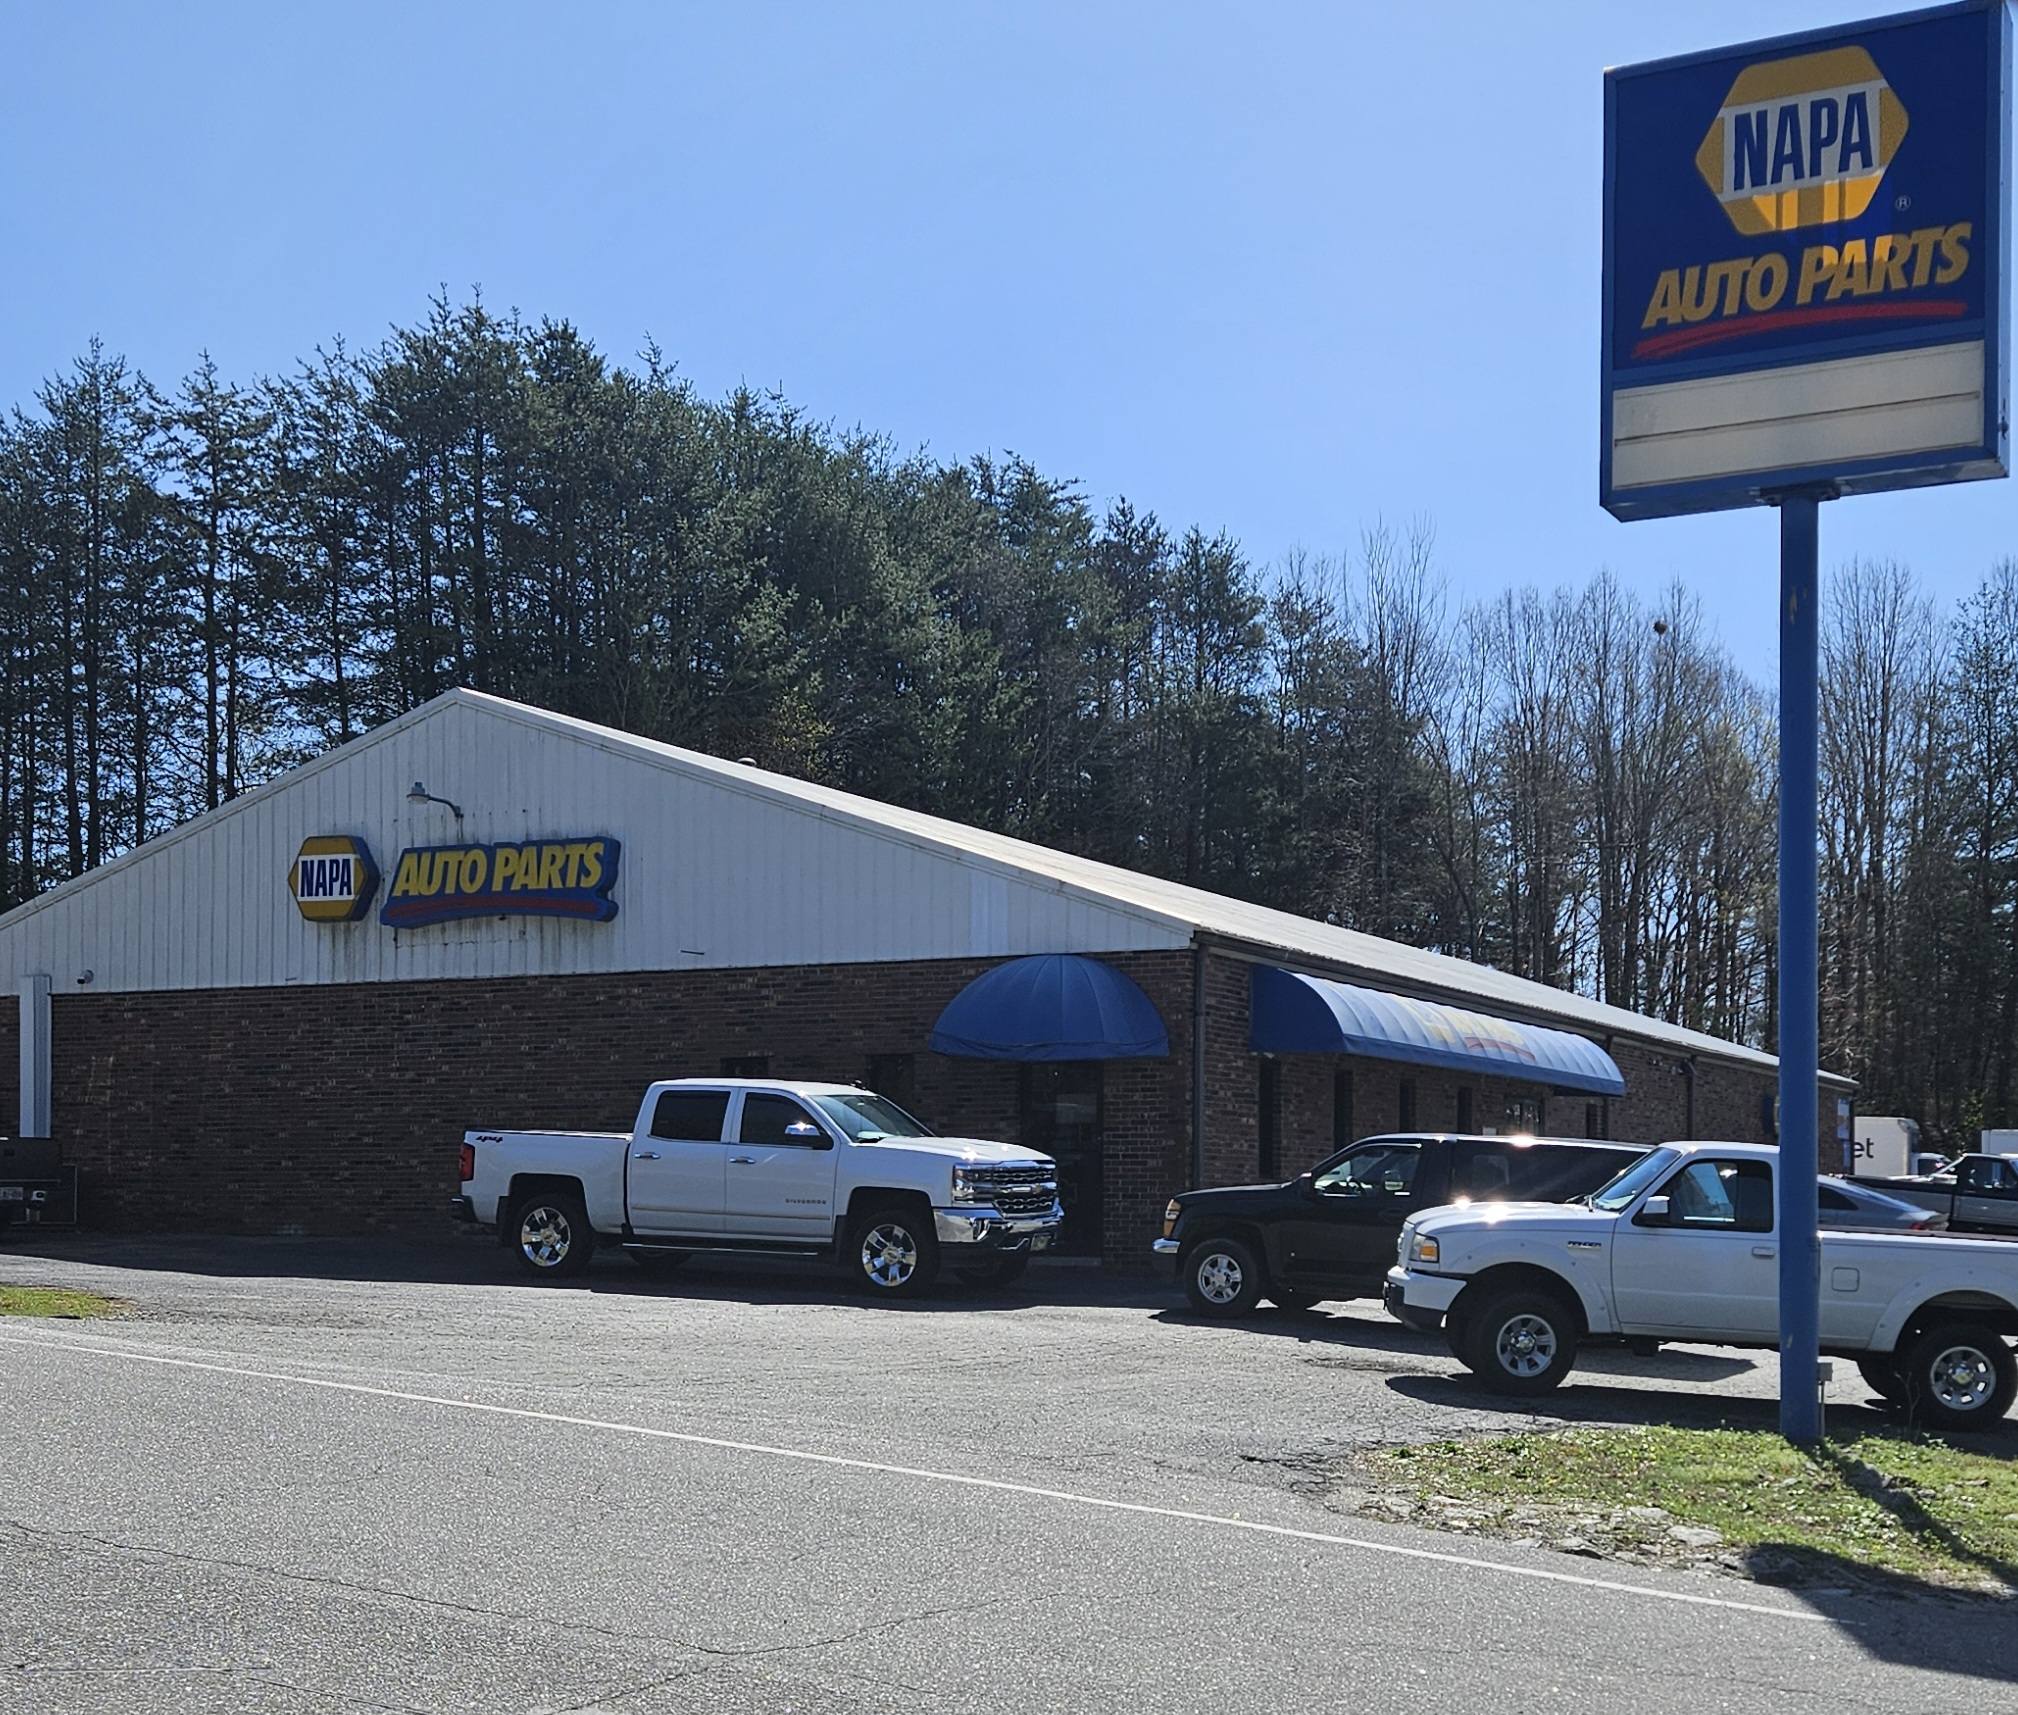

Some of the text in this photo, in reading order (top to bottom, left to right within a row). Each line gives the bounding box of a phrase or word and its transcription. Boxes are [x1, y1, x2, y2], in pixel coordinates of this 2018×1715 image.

[1733, 92, 1873, 191] NAPA
[1642, 222, 1973, 329] AUTO PARTS
[301, 859, 352, 897] NAPA
[393, 843, 604, 897] AUTO PARTS
